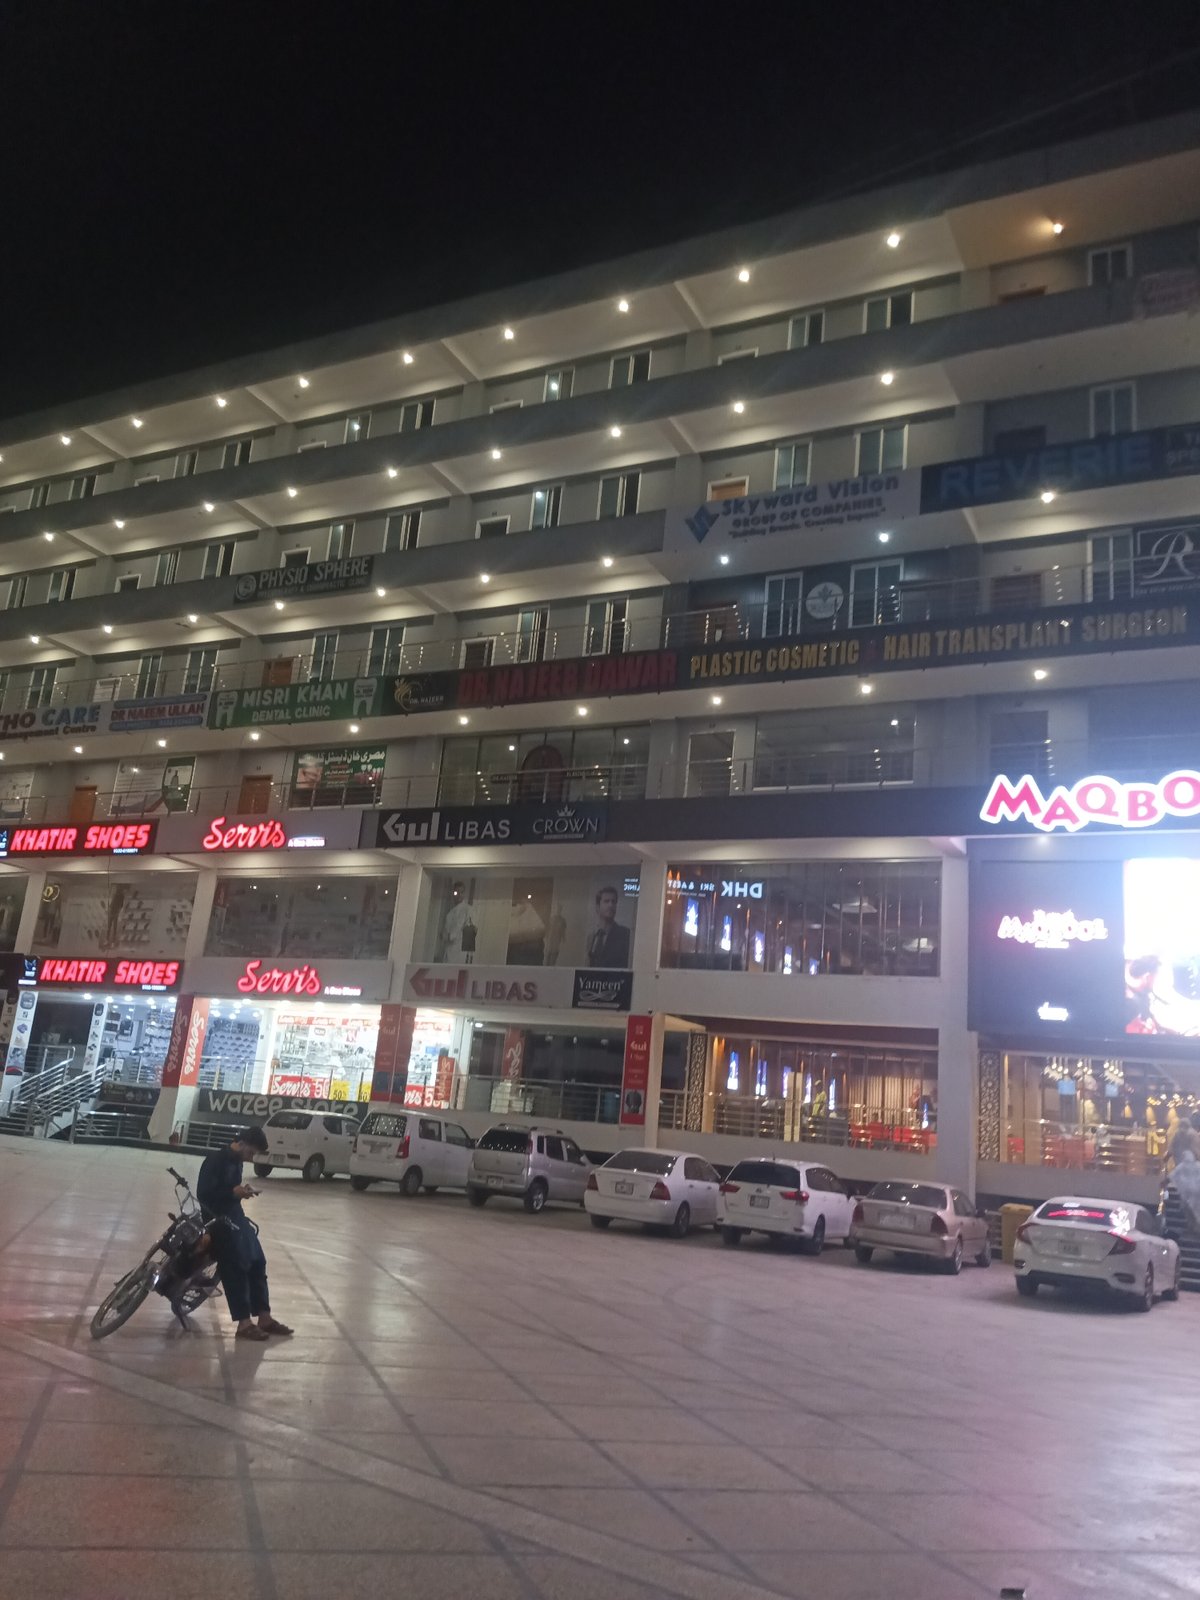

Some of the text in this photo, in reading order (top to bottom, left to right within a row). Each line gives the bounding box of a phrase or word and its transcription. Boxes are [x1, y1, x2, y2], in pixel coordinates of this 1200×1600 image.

[941, 437, 1152, 501] REVERIE
[723, 476, 899, 518] Skyward Vision
[732, 497, 883, 529] GROUP OF COMPANIES
[1143, 529, 1194, 579] R
[258, 556, 371, 590] PHYSIO SPHERE
[494, 662, 579, 701] NAJEEB
[585, 651, 679, 691] DAWAR
[690, 647, 762, 680] PLASTIC
[765, 639, 860, 673] COSMETIC
[883, 631, 931, 662] HAIR
[936, 617, 1075, 657] TRANSPLANT
[1082, 605, 1188, 643] SURGEON
[243, 688, 290, 709] MISRI
[297, 681, 348, 702] KHAN
[42, 704, 101, 726] CARE
[111, 710, 126, 721] DR
[168, 703, 205, 717] ULLAH
[252, 705, 331, 723] DENTAL CLINIC
[981, 771, 1200, 832] MAQBO
[10, 828, 78, 851] KHATIR
[84, 823, 151, 849] SHOES
[203, 816, 286, 850] Servis
[382, 811, 511, 842] Gul LIBAS
[533, 817, 599, 835] CROWN
[40, 959, 108, 983] KHATIR
[115, 960, 179, 985] SHOES
[237, 959, 321, 995] Servis
[408, 967, 539, 1002] Gul LIBAS
[579, 976, 621, 994] Yameen
[167, 1008, 188, 1072] Servis
[185, 1010, 205, 1075] Servis
[271, 1074, 311, 1098] Servis
[208, 1090, 359, 1117] wazee store
